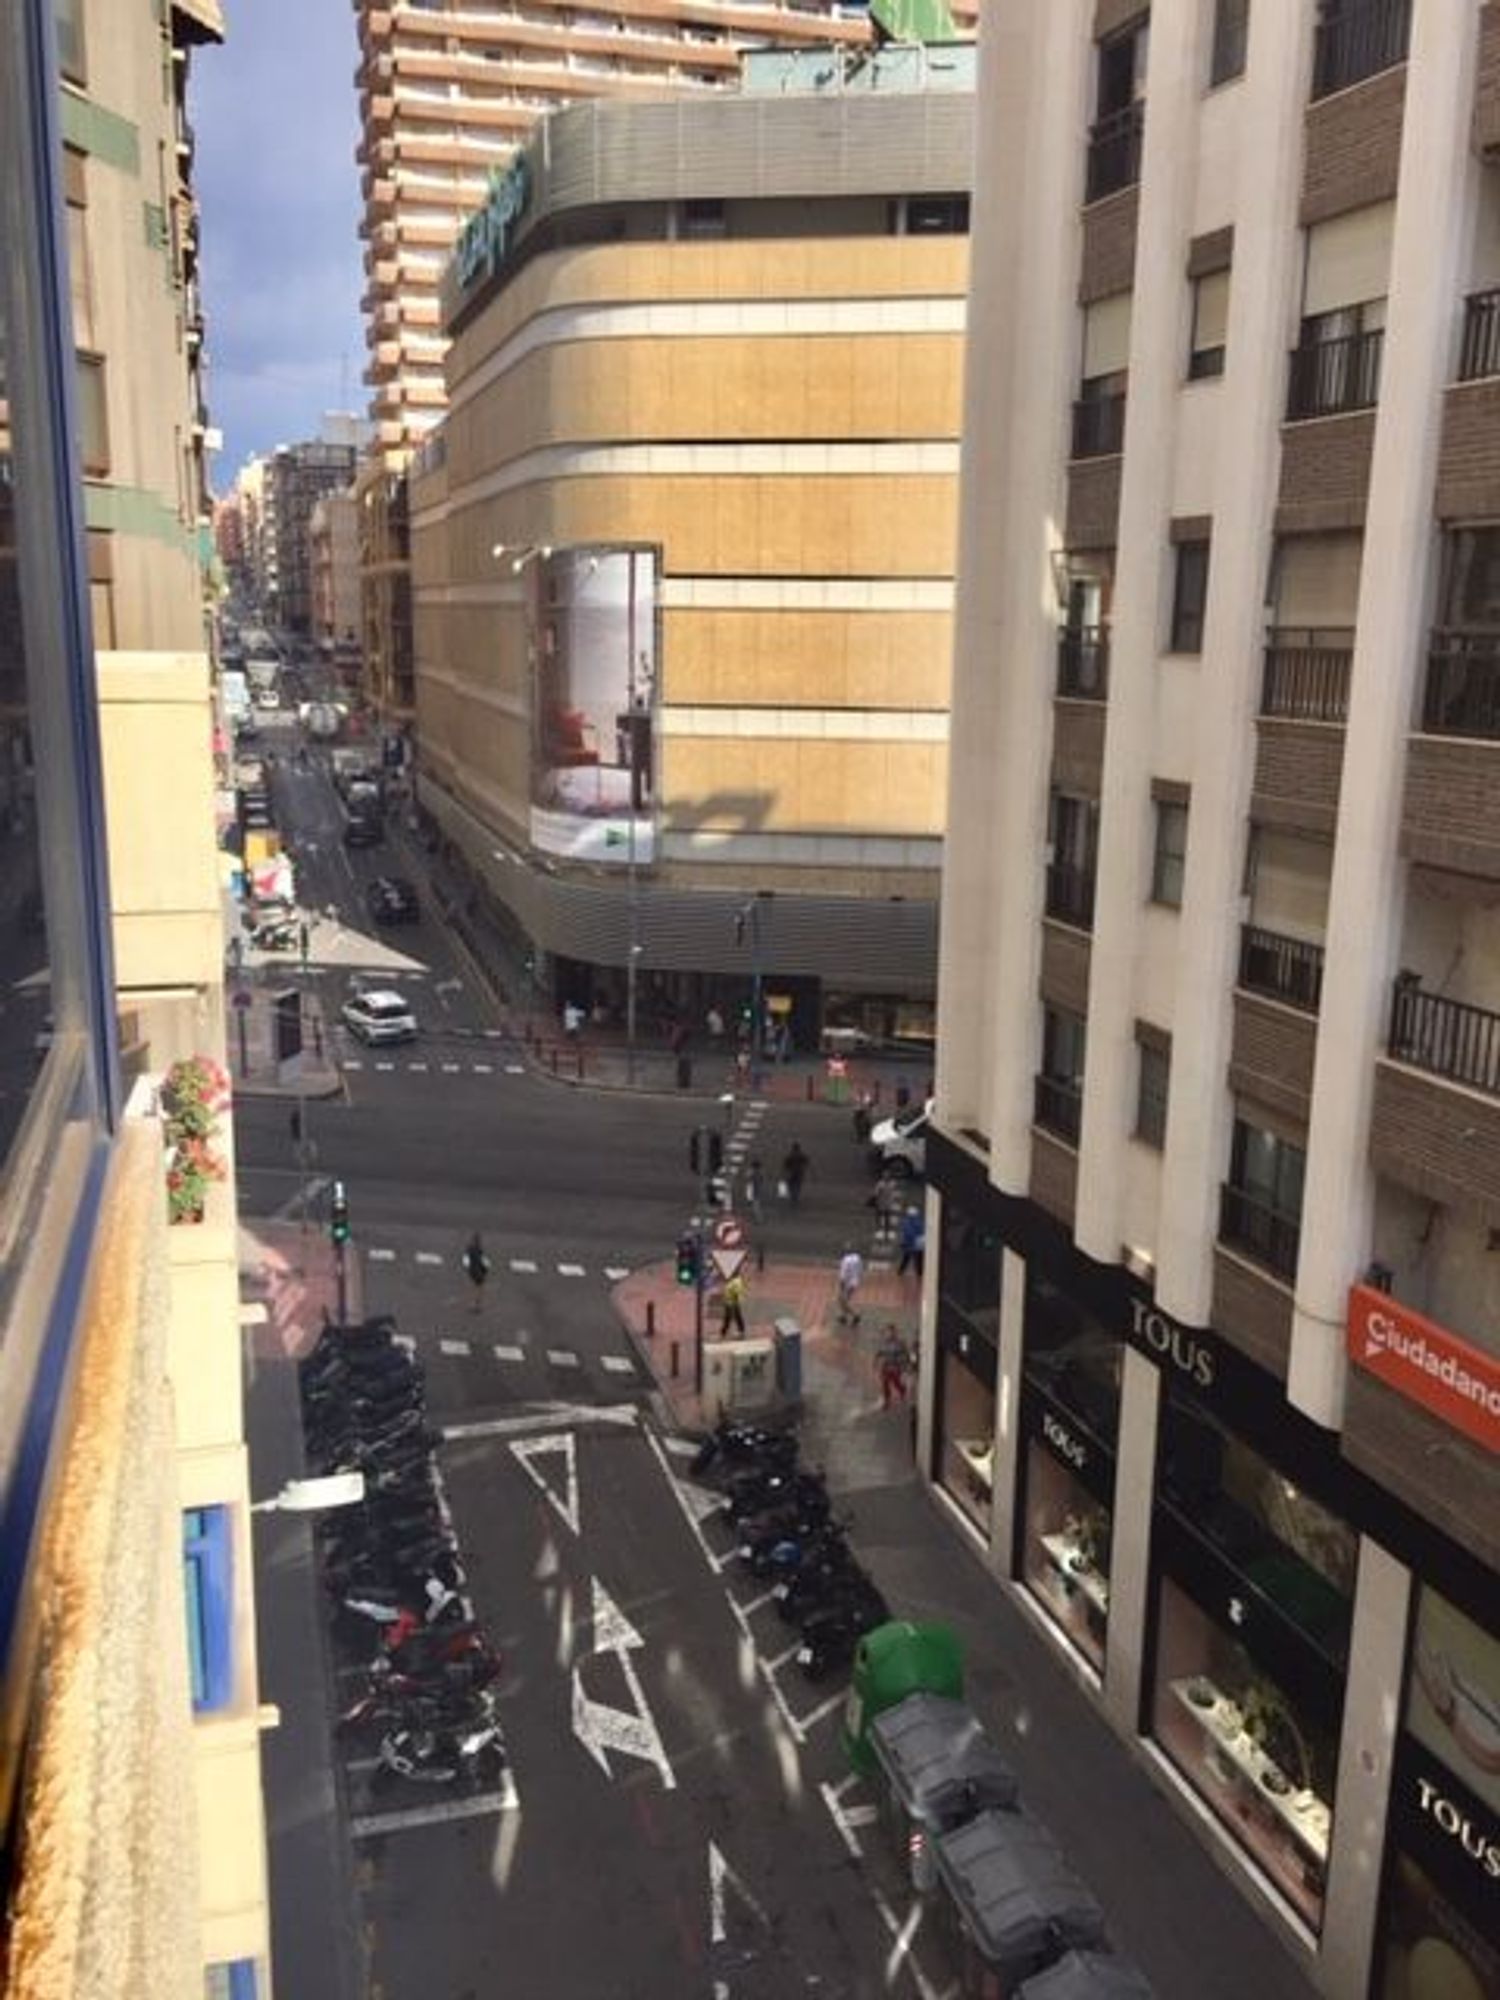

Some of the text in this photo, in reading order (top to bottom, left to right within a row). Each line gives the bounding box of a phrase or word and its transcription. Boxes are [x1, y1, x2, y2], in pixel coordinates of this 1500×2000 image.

[1128, 1298, 1214, 1386] TOUS
[1043, 1412, 1086, 1469] TOUS
[1417, 1777, 1500, 1877] TOUS
